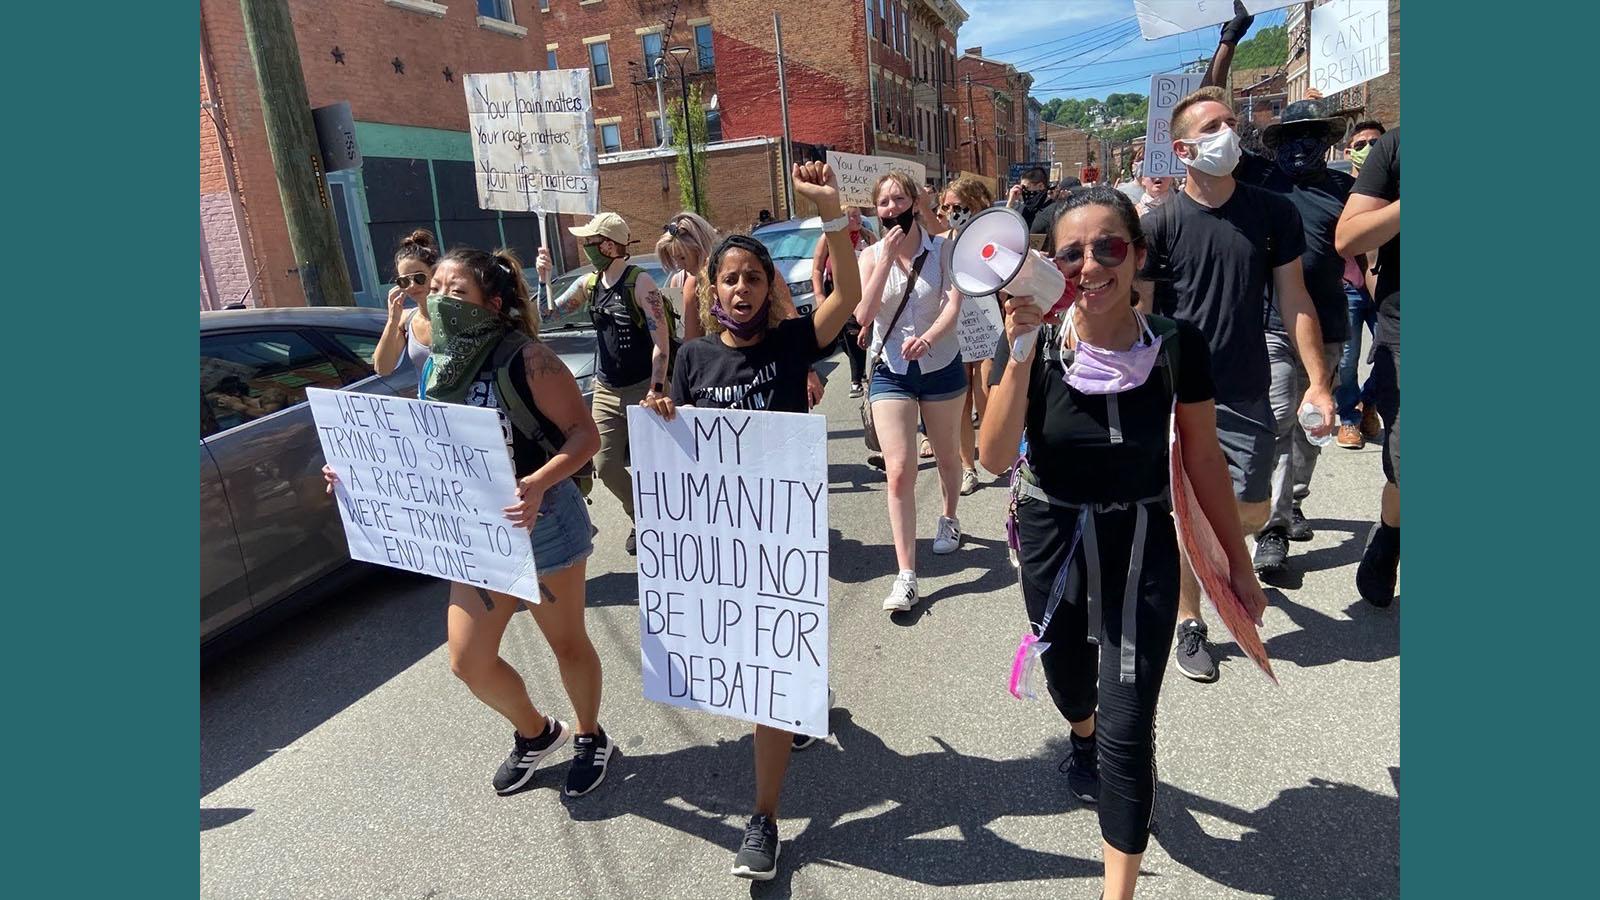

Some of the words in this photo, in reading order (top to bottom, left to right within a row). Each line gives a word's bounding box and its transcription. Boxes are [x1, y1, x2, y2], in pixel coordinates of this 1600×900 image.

[1322, 10, 1381, 57] CAN'T
[1314, 36, 1388, 90] BREATHE
[476, 84, 512, 120] Your
[518, 97, 543, 126] pain
[475, 125, 498, 145] Your
[502, 129, 527, 151] rage
[531, 128, 571, 145] matters.
[480, 159, 511, 190] Your
[514, 163, 536, 190] life
[834, 155, 853, 170] You
[858, 159, 878, 173] Can't
[842, 173, 868, 184] BLACK
[336, 394, 399, 432] WE'RE
[408, 403, 451, 438] NOT
[694, 415, 751, 464] MY
[320, 426, 386, 463] TRYING
[389, 435, 417, 468] TO
[425, 439, 492, 482] START
[349, 465, 364, 492] A
[372, 467, 478, 515] RACEWAR,
[637, 471, 823, 538] HUMANITY
[345, 496, 397, 532] WE'RE
[402, 507, 472, 548] TRYING
[479, 522, 512, 557] TO
[383, 536, 425, 570] END
[433, 545, 488, 585] ONE.
[640, 529, 747, 588] SHOULD
[760, 543, 829, 598] NOT
[645, 590, 687, 637] BE
[700, 598, 742, 646] UP
[755, 604, 820, 667] FOR
[667, 651, 802, 726] DEBATE.
